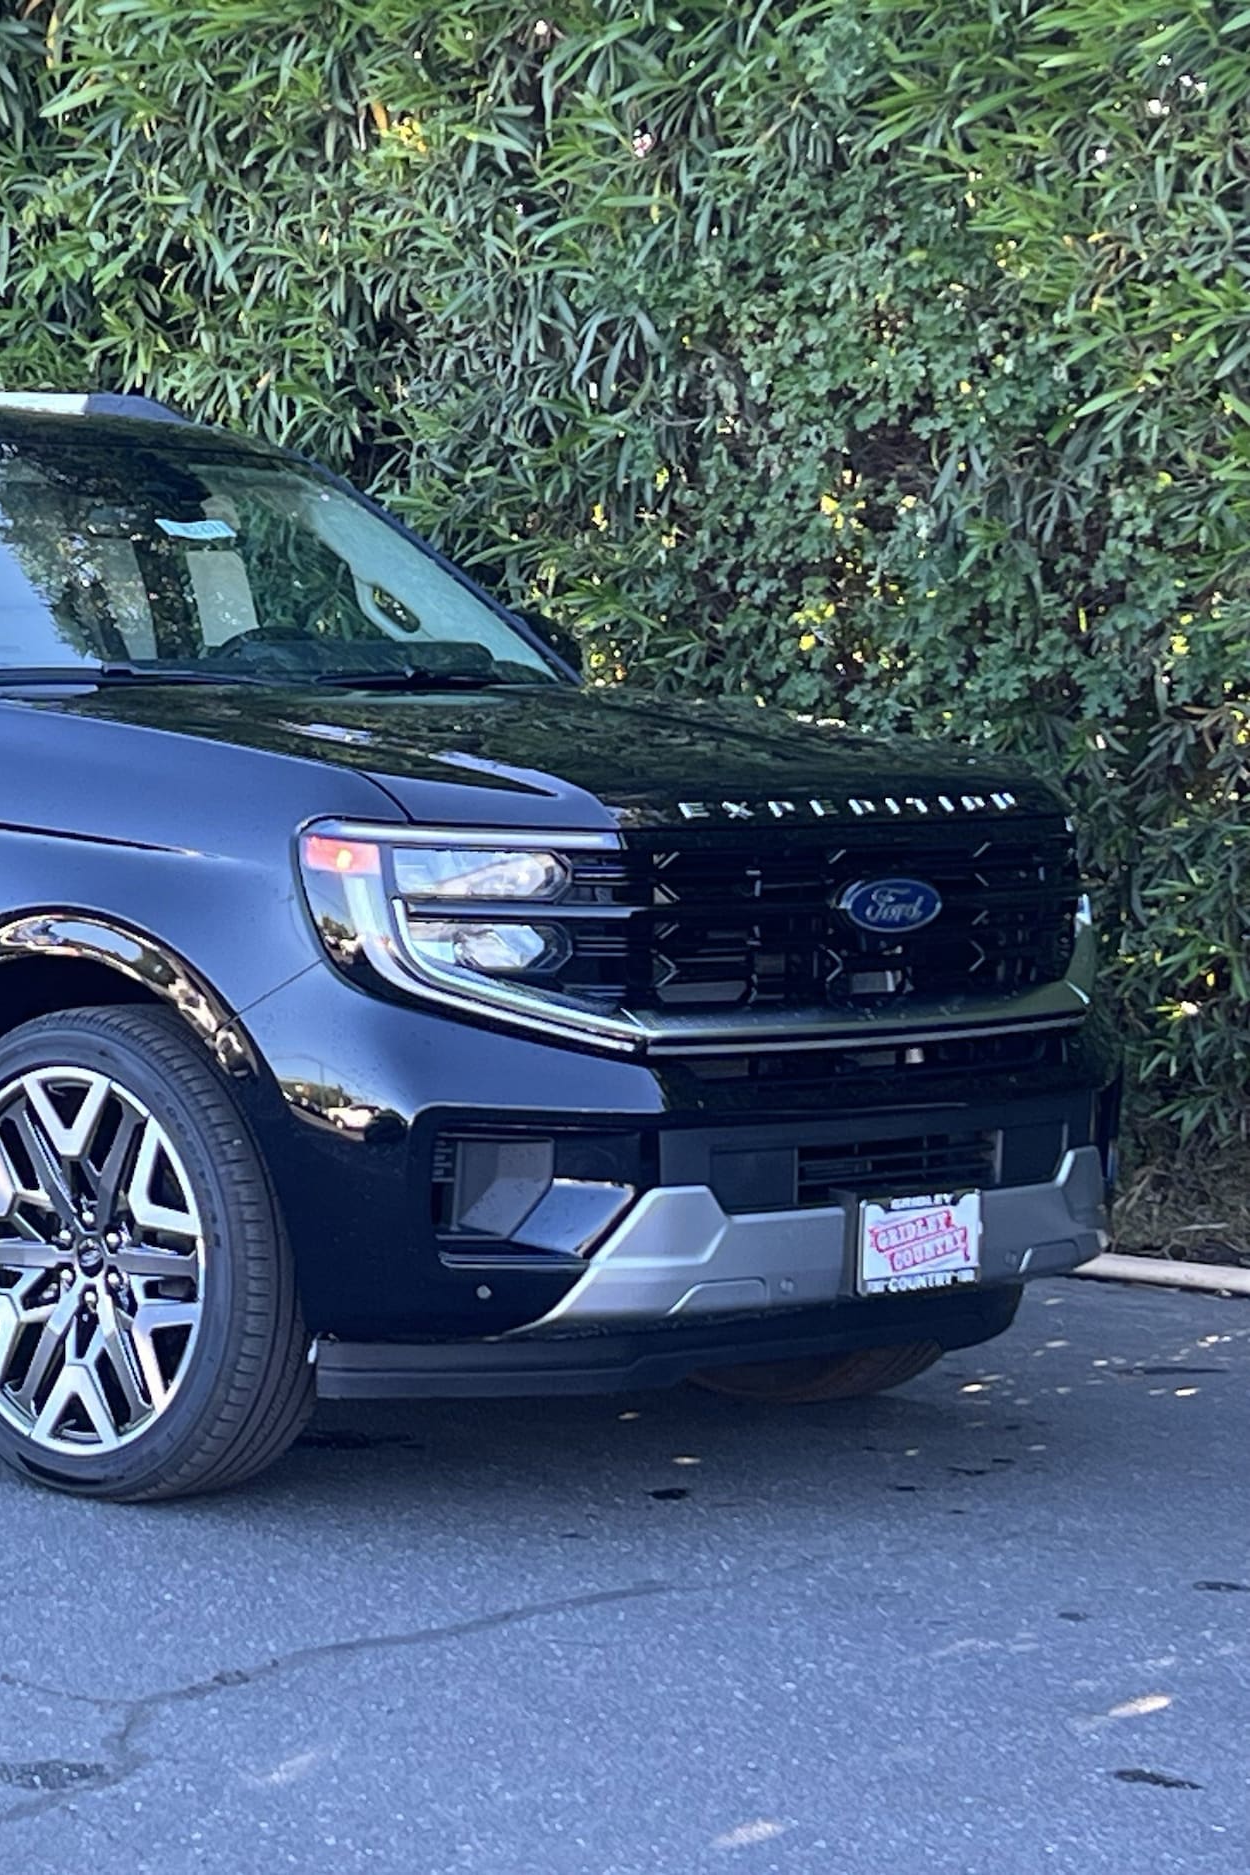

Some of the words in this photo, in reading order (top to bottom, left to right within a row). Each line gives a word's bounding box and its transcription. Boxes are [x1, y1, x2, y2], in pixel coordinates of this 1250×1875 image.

[864, 886, 925, 923] Ford
[876, 1212, 949, 1250] GRIDLEY
[892, 1229, 965, 1271] COUNTRY
